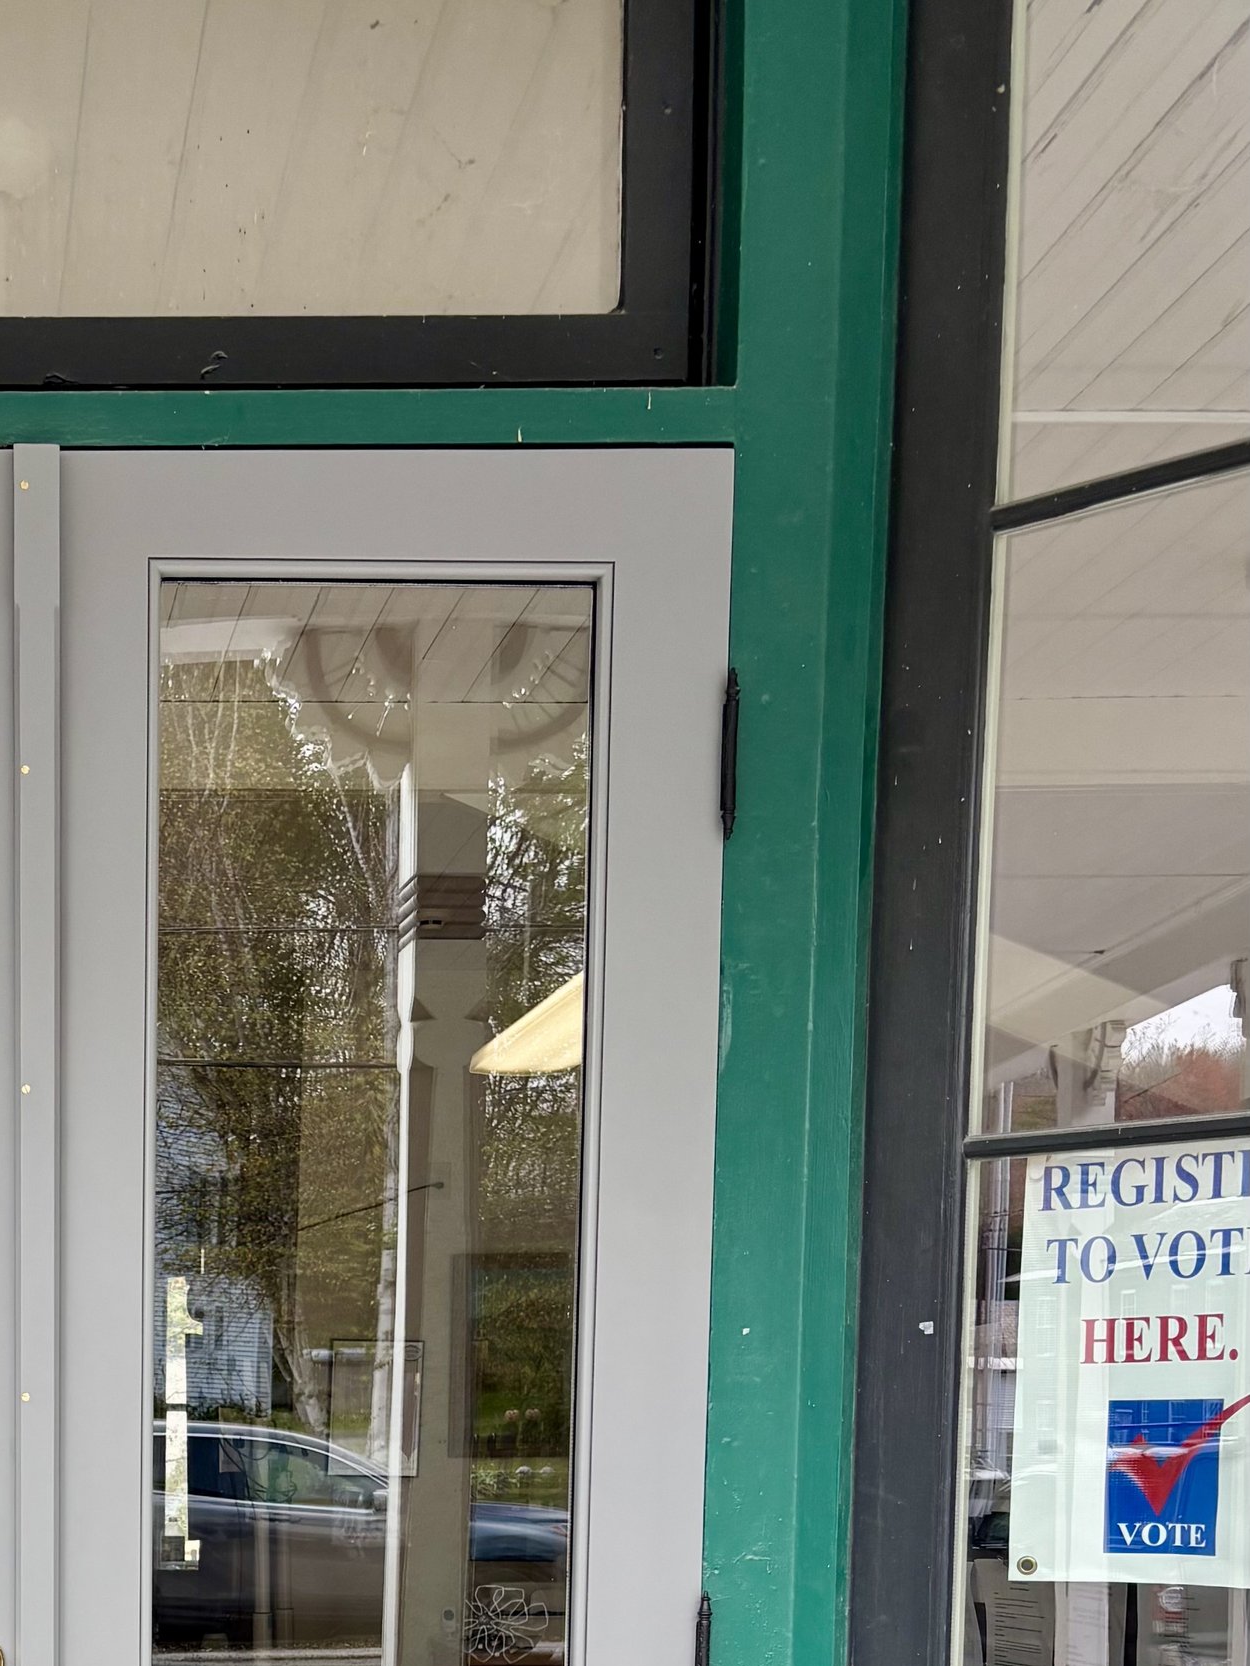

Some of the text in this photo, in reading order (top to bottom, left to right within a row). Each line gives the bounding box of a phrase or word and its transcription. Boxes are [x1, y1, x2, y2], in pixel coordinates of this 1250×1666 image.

[1038, 1149, 1250, 1213] REGIST
[1046, 1226, 1250, 1285] TO VOT
[1079, 1312, 1239, 1366] HERE.
[1116, 1521, 1207, 1549] VOTE
